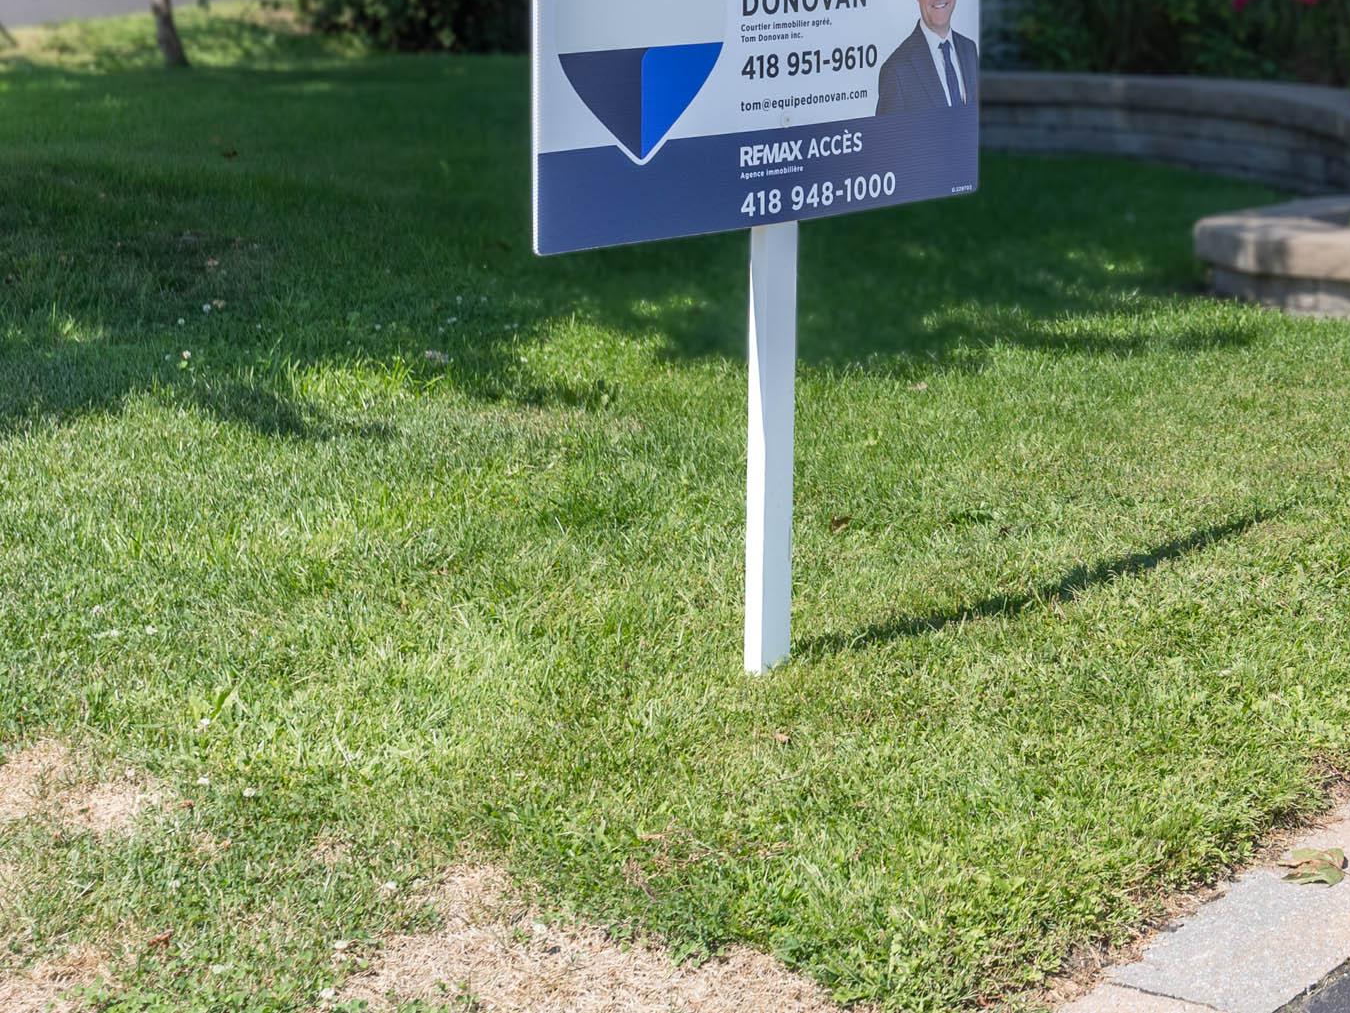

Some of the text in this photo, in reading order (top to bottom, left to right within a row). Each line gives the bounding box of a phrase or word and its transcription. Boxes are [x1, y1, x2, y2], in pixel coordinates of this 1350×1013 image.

[740, 22, 771, 33] Courtier
[773, 19, 811, 31] immobilier
[740, 31, 804, 44] Tom Donovan inc.
[741, 44, 878, 80] 418 951-9610
[740, 89, 868, 112] tom@equipedonovan.com
[807, 129, 863, 159] ACCÈS
[740, 165, 804, 180] Agence immobilière
[740, 171, 896, 217] 418 948-1000
